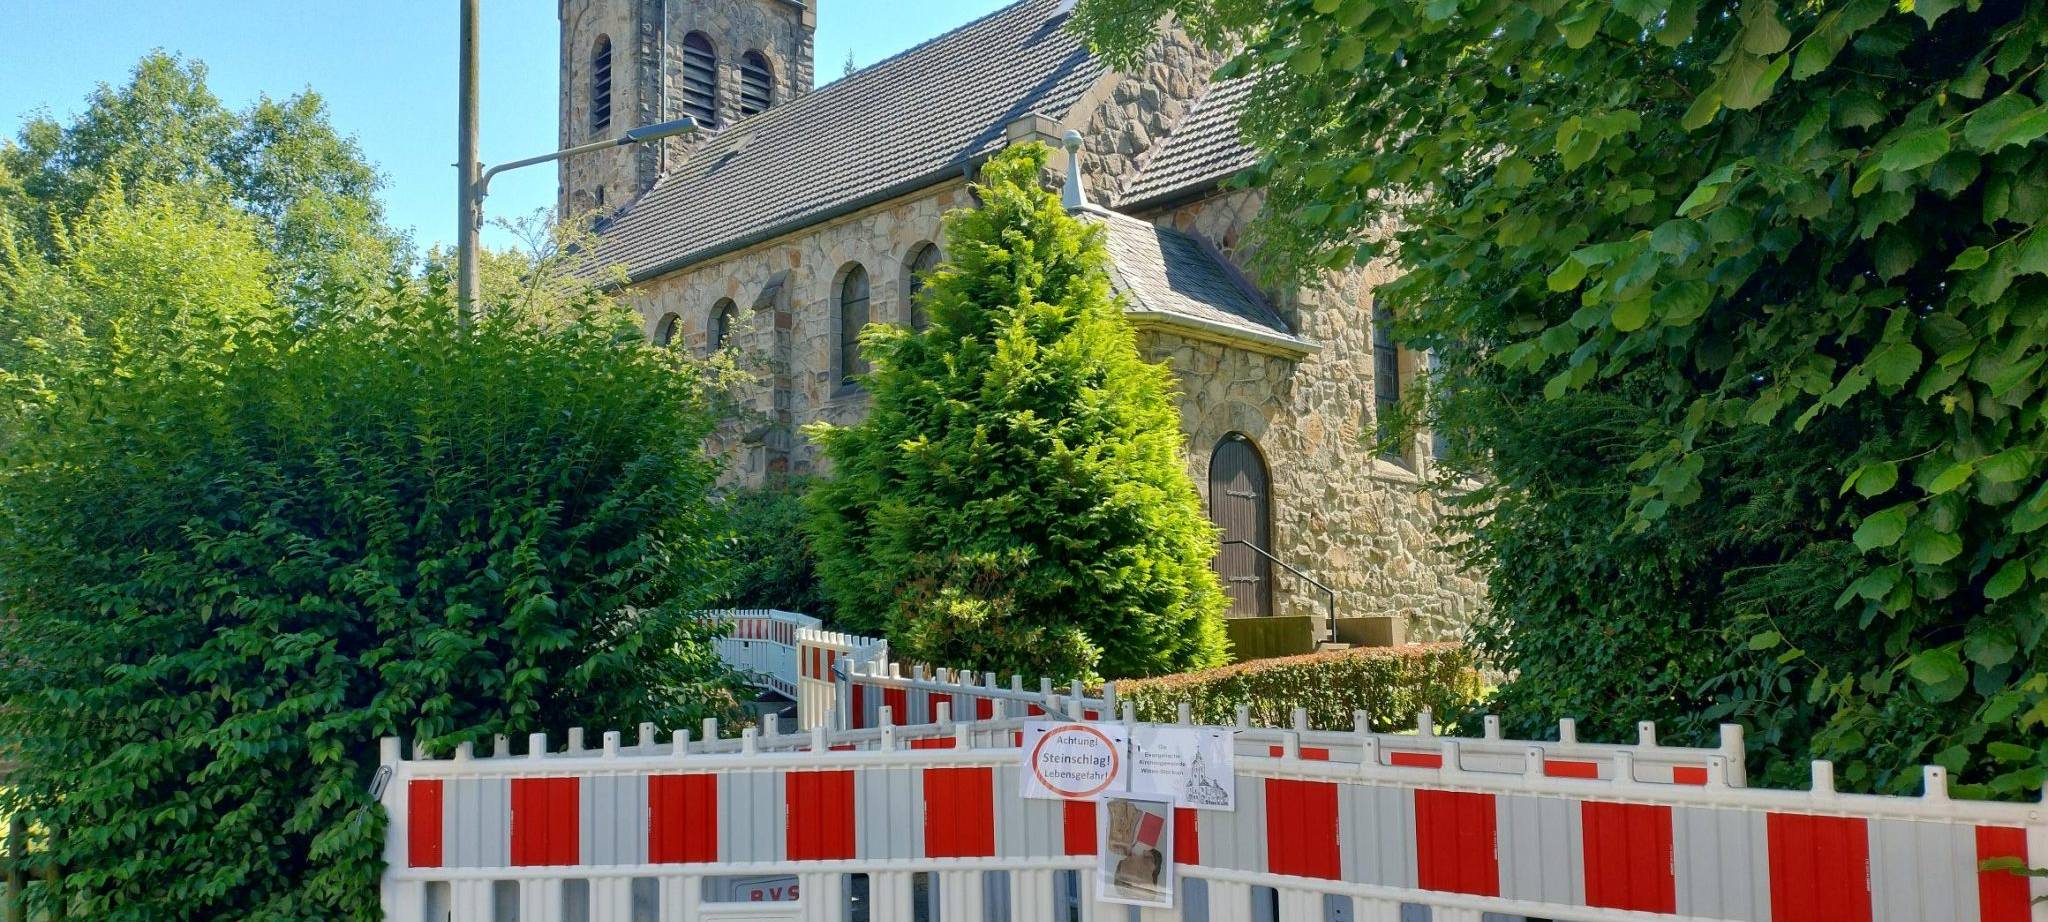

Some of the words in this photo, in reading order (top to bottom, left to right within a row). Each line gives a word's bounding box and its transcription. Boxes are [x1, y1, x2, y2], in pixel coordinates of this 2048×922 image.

[1057, 736, 1099, 747] Achtung!
[1043, 753, 1111, 768] Steinschlag!
[1045, 770, 1108, 782] Lebensgefahr!
